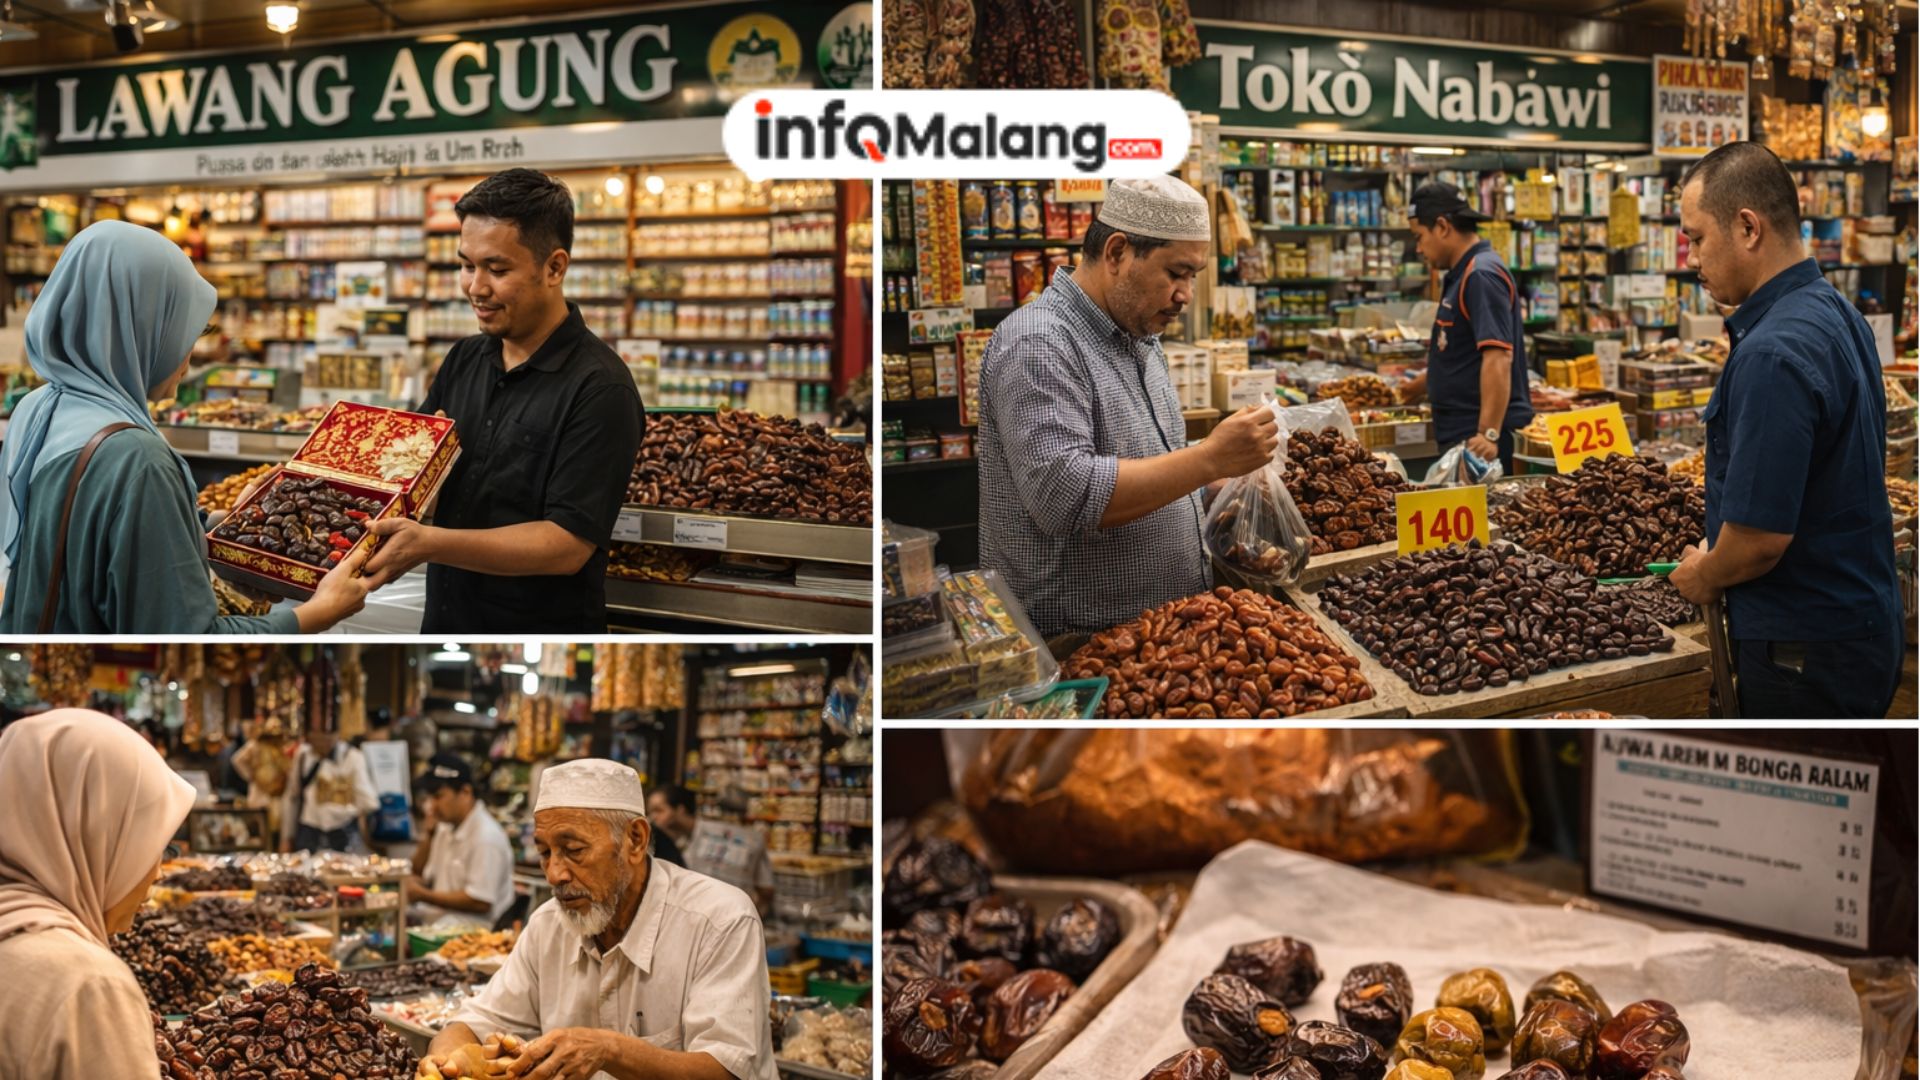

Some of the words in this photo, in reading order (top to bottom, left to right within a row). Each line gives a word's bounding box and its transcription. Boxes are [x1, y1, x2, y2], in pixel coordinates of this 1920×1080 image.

[56, 55, 354, 142] LAWANG
[372, 24, 678, 121] AGUNG
[1558, 418, 1615, 455] 225
[1408, 506, 1475, 546] 140
[1714, 749, 1729, 772] M
[1735, 753, 1803, 783] BONGA
